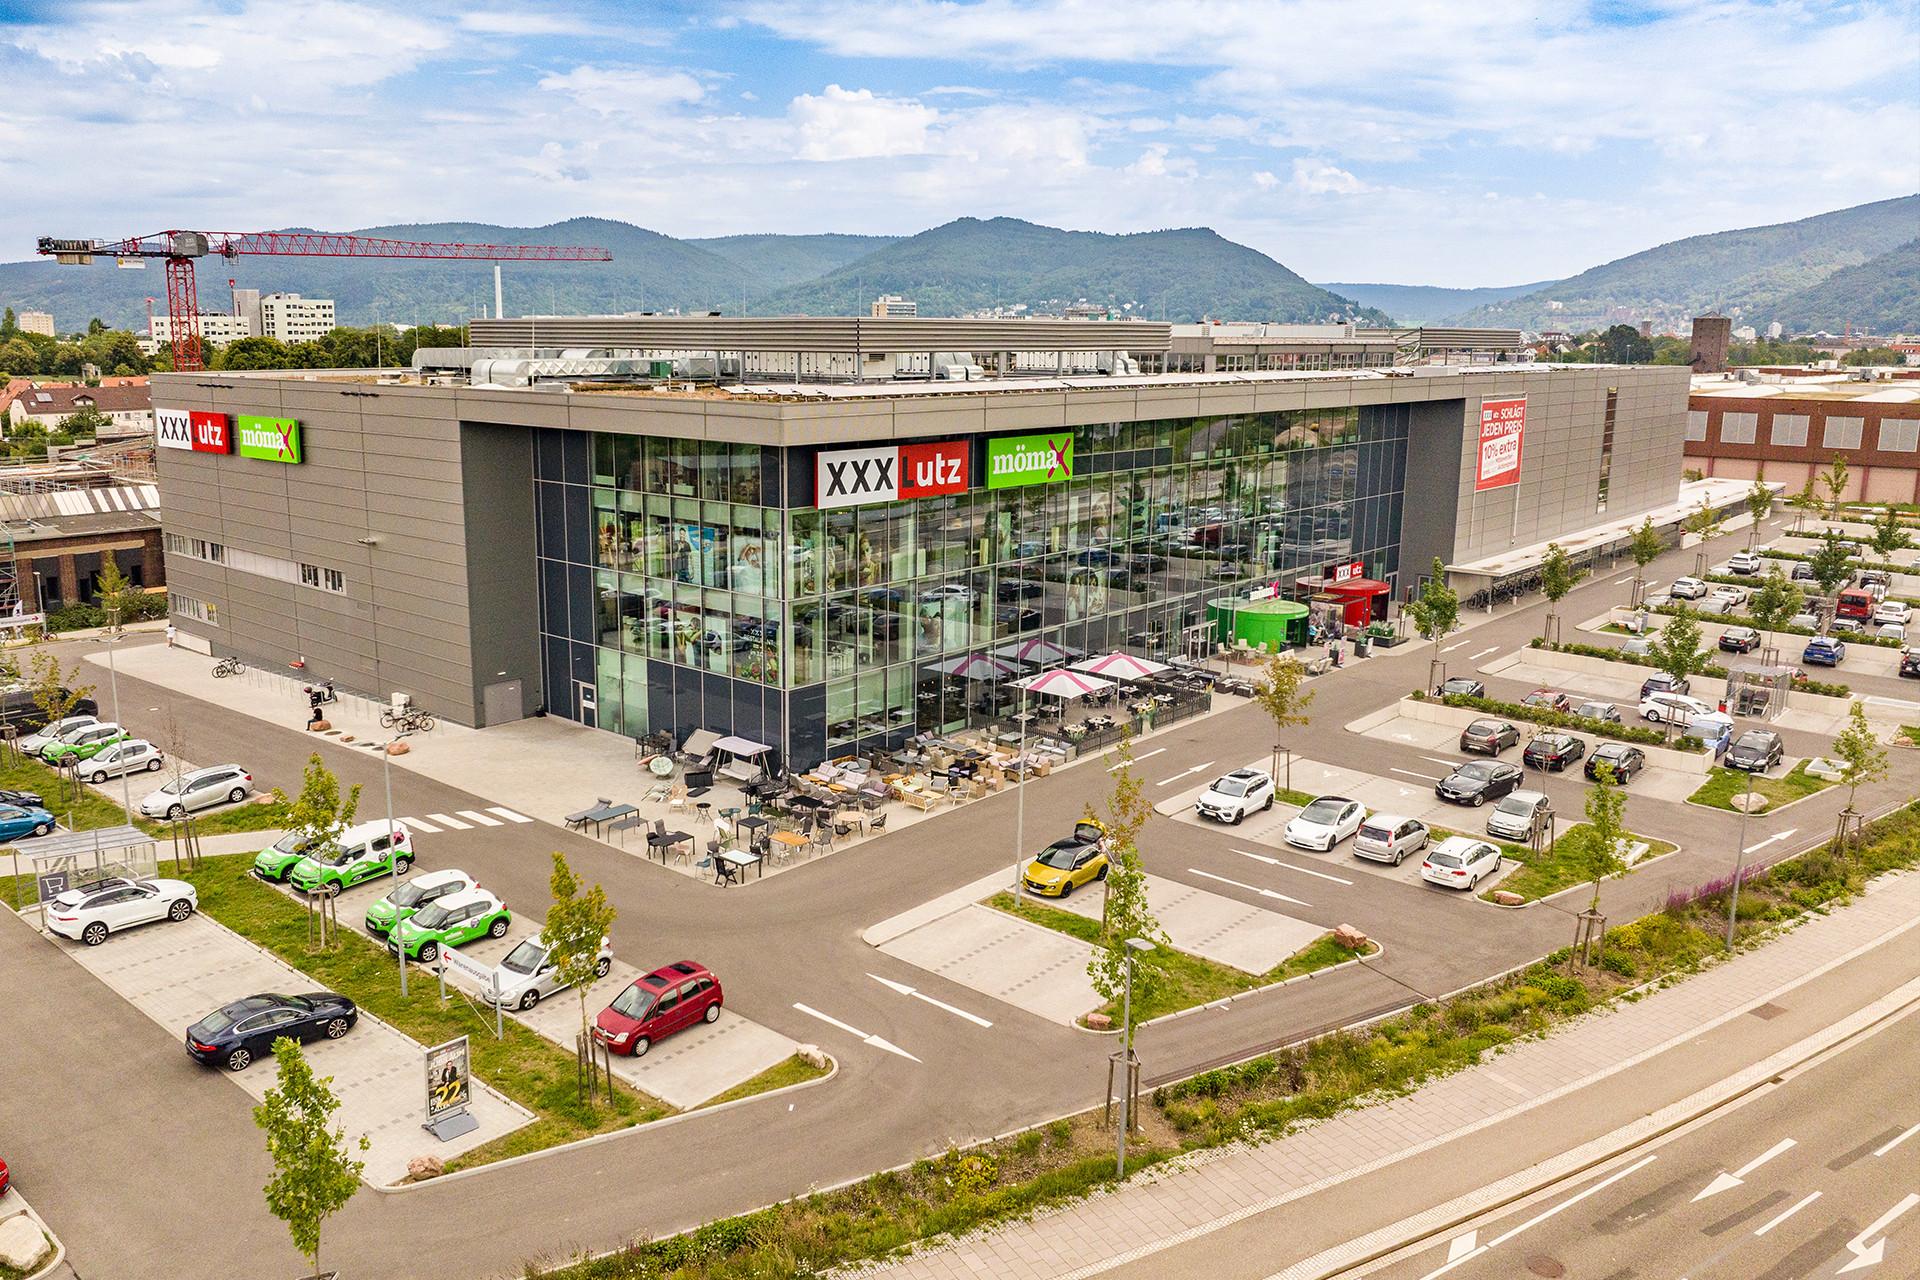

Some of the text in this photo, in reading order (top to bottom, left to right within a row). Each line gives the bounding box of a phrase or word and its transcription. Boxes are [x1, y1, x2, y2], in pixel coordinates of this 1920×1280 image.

[1501, 405, 1524, 420] SCHLÄGT
[1482, 420, 1523, 437] JEDEN PREIS
[1484, 440, 1517, 460] 10% extra
[826, 453, 962, 496] XXXLutz
